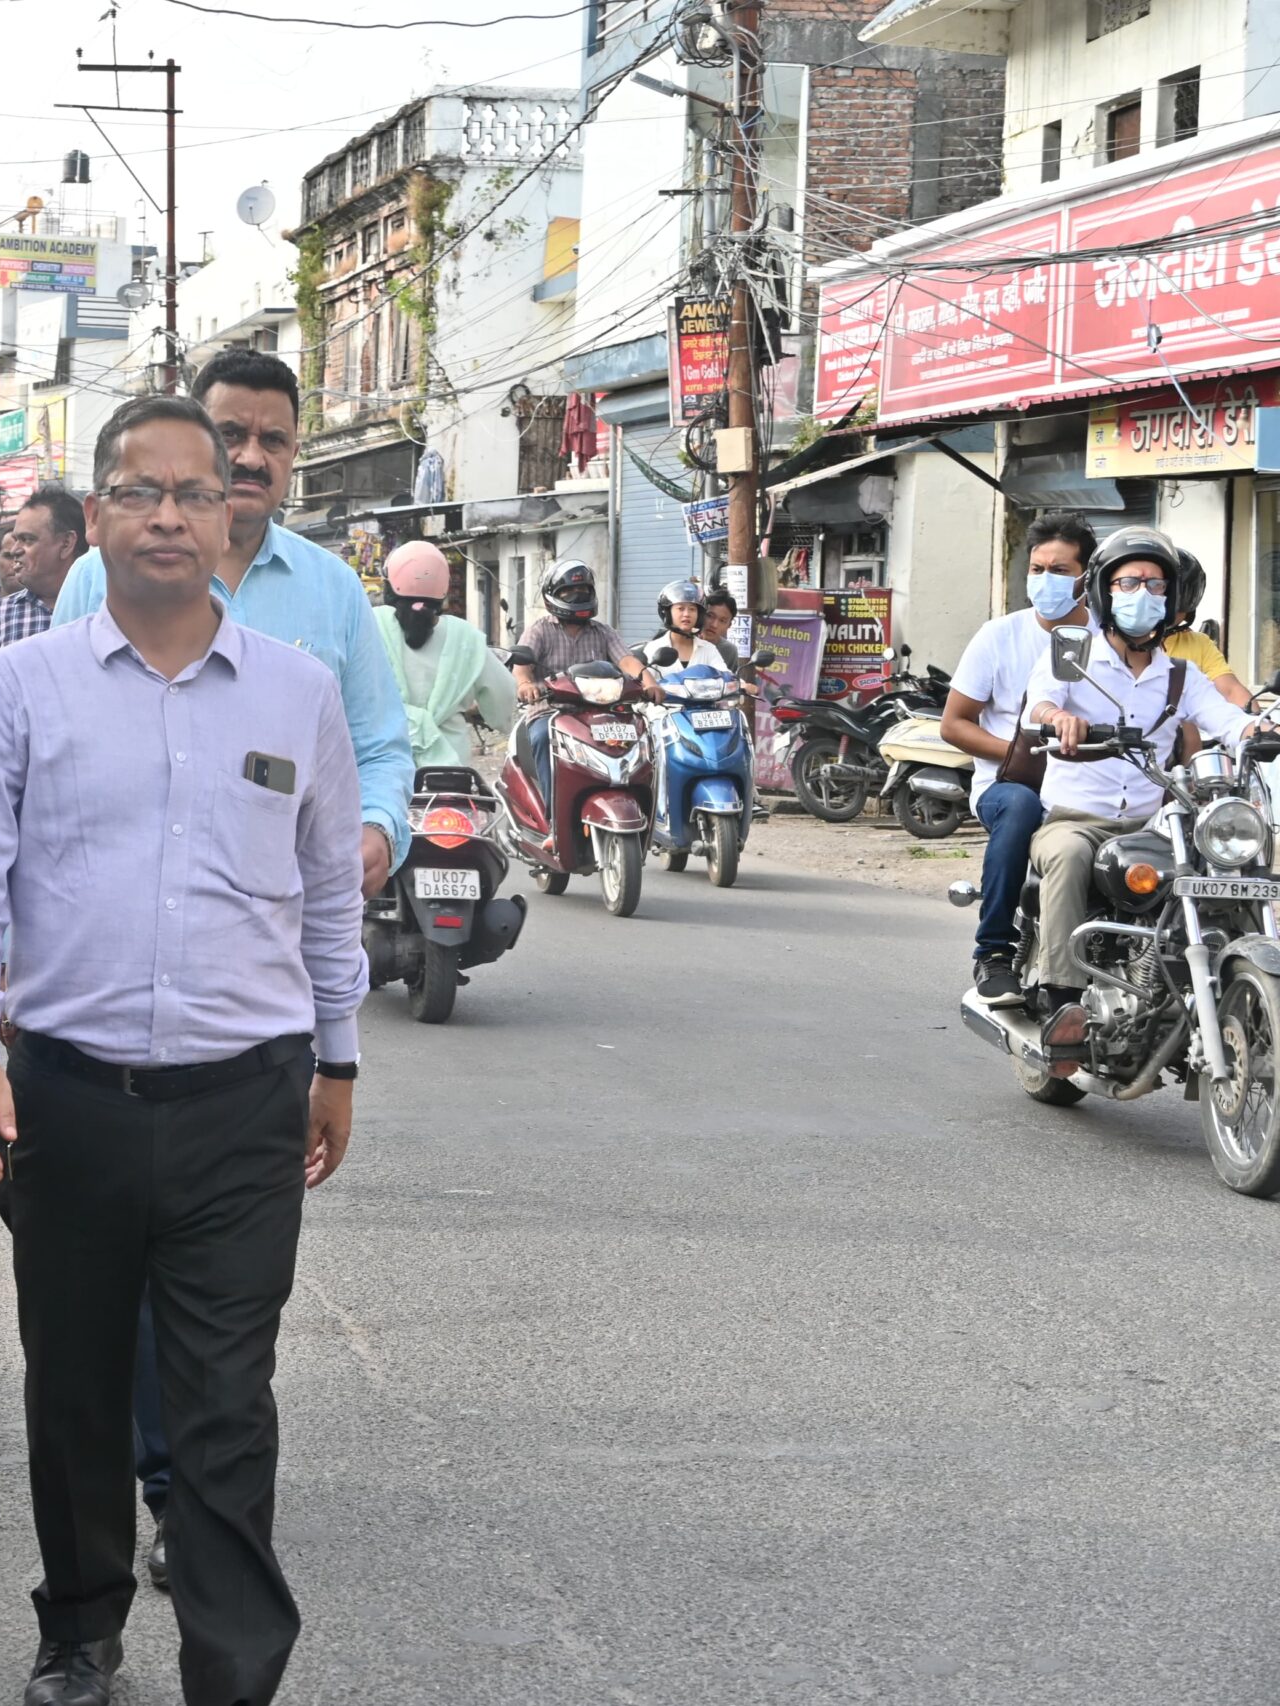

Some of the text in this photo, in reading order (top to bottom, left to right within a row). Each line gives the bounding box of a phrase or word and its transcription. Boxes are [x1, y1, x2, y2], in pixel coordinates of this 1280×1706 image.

[0, 238, 96, 256] AMBITION ACADEMY
[1129, 392, 1217, 452] जगदीश
[771, 624, 811, 642] Mutton
[603, 725, 627, 733] UK07
[432, 871, 468, 884] UK07
[423, 883, 478, 897] DA6679
[1192, 882, 1228, 896] UK07
